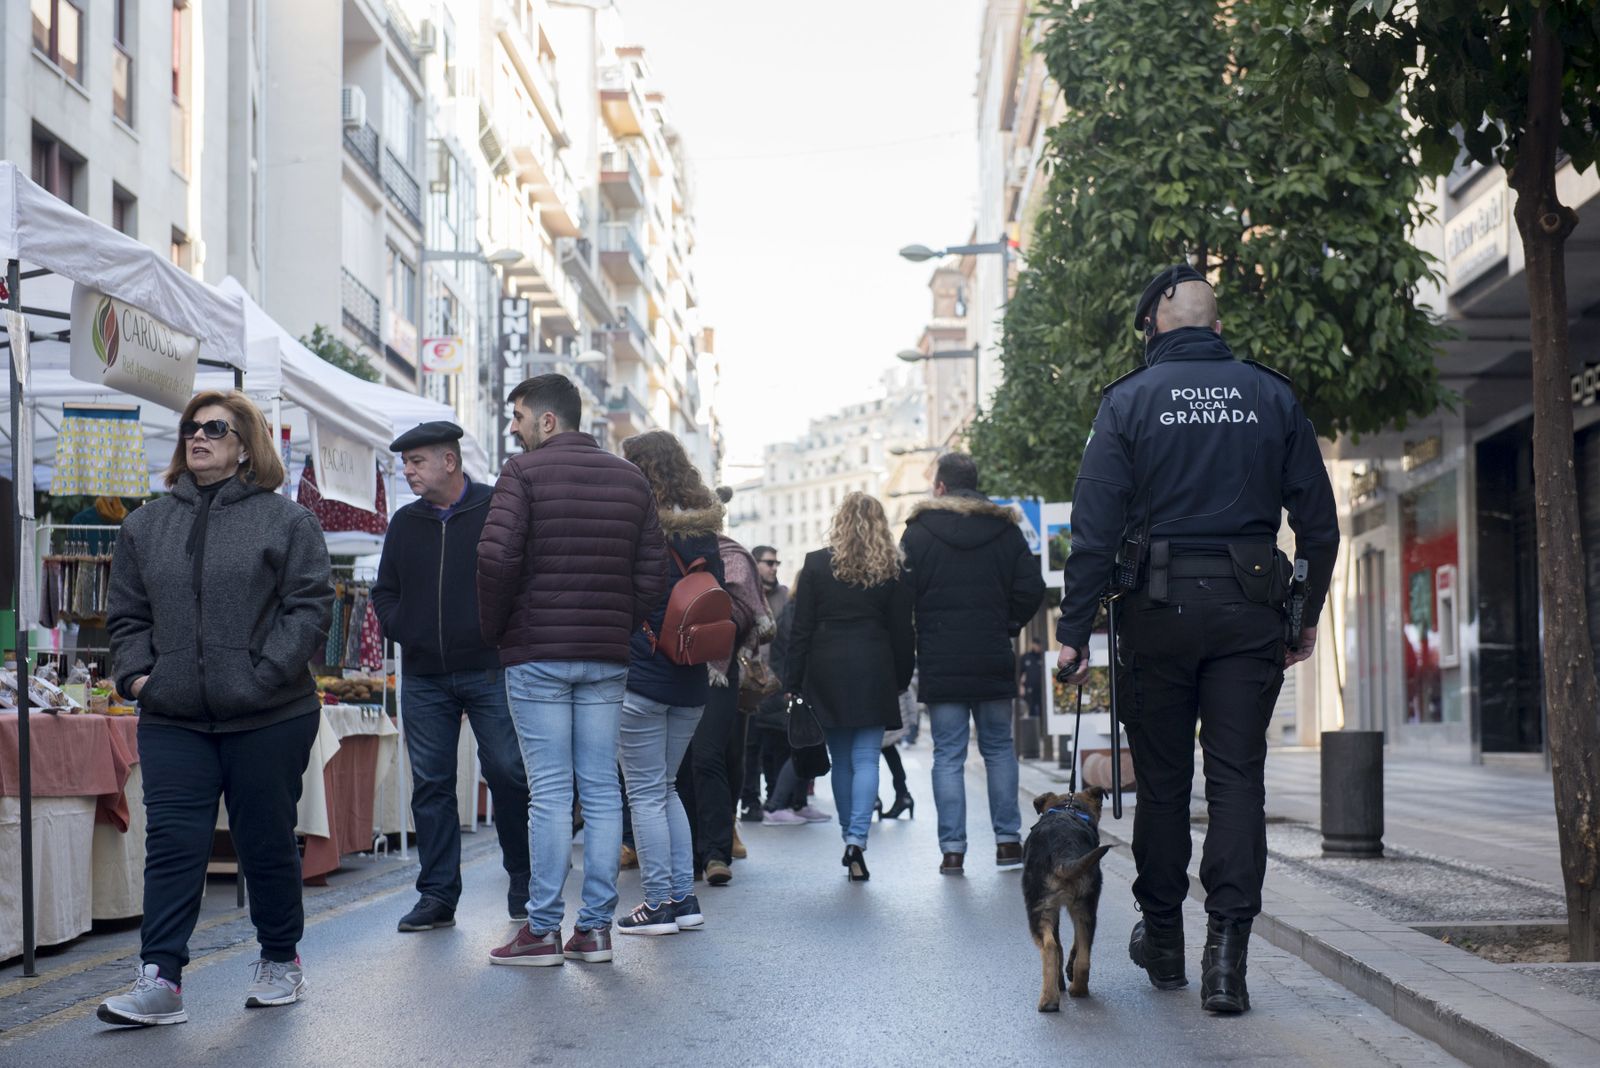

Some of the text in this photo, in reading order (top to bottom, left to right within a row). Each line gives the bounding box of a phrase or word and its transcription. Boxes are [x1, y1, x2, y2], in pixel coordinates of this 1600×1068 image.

[1171, 387, 1242, 400] POLICIA
[1190, 401, 1227, 409] LOCAL
[1160, 409, 1258, 425] GRANADA
